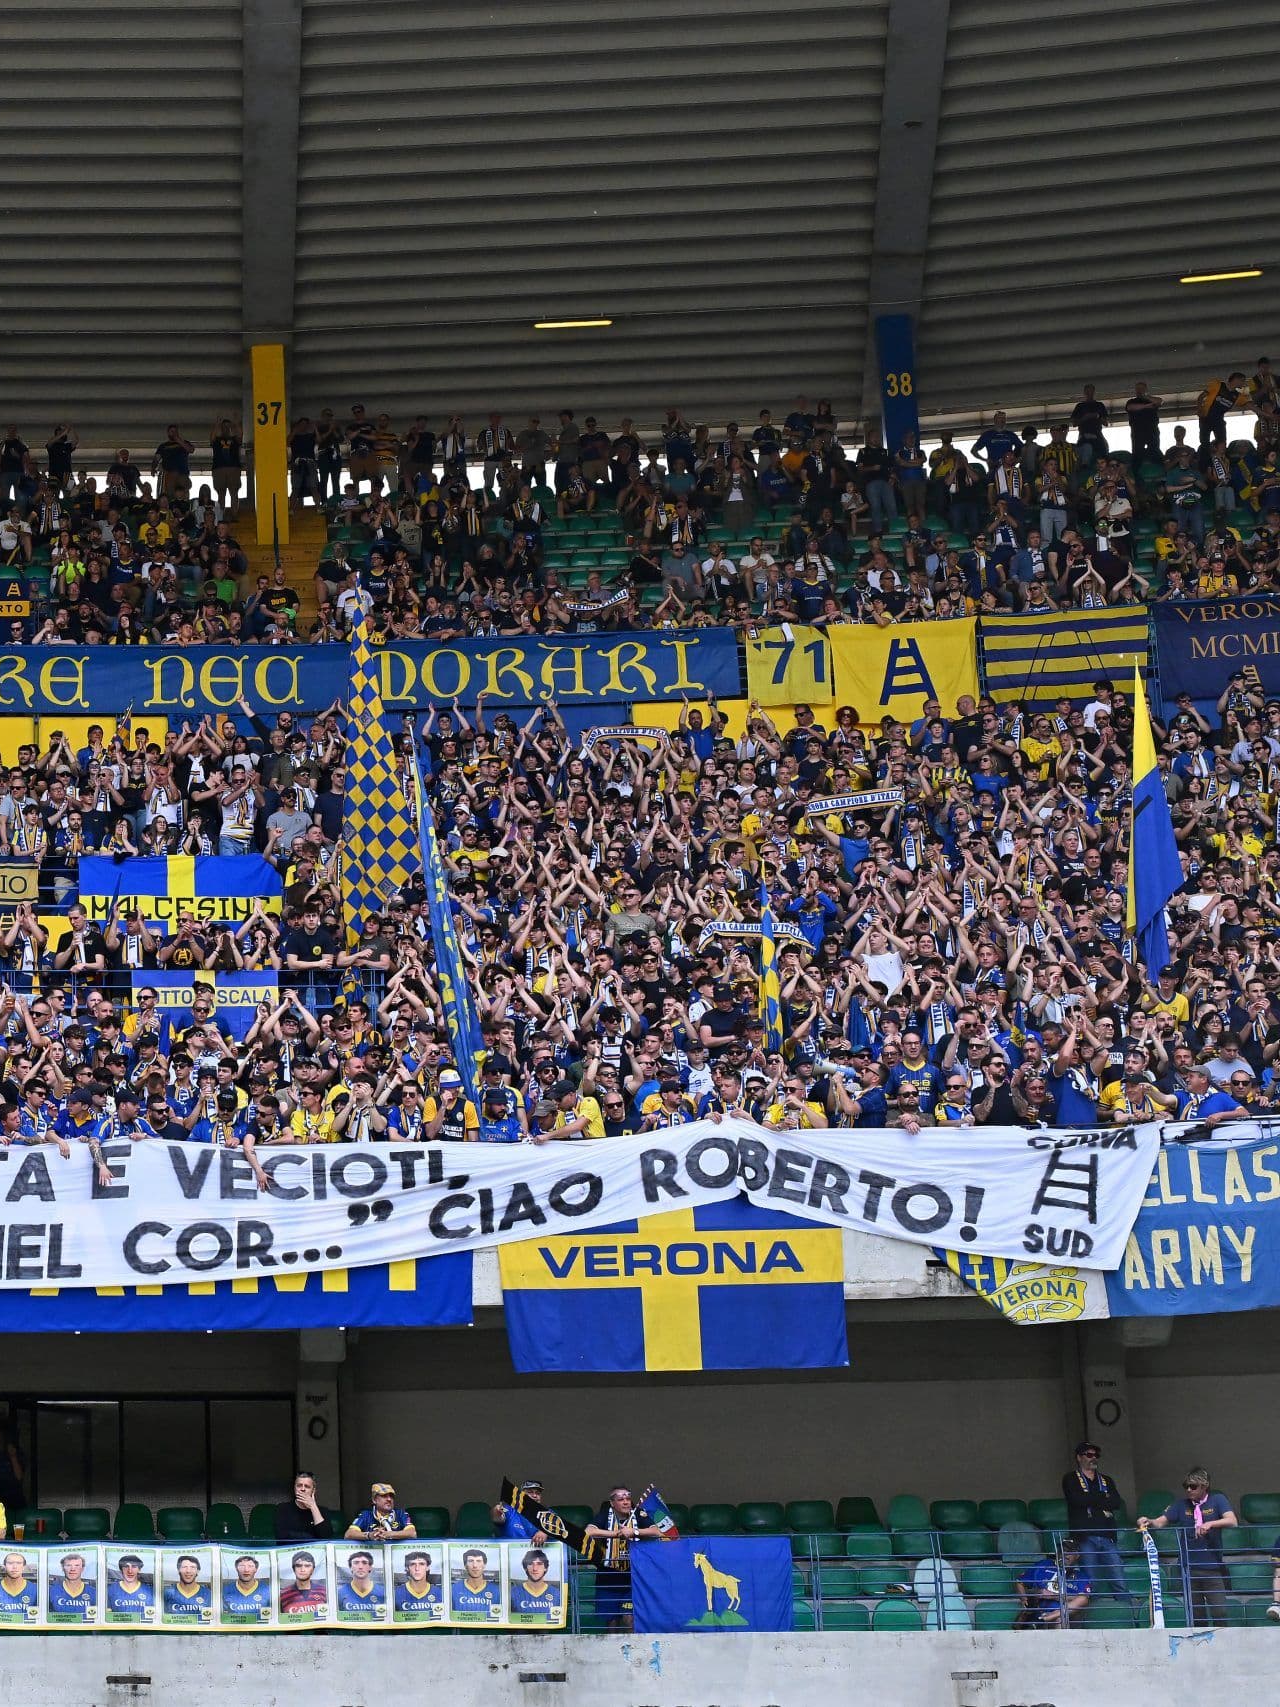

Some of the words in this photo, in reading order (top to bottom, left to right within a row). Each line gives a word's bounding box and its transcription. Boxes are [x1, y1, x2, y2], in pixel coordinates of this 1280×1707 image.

[886, 373, 913, 397] 38
[257, 402, 281, 425] 37
[144, 655, 305, 709] NEC
[217, 989, 272, 1004] SCALA
[91, 1144, 132, 1200] E
[428, 1170, 604, 1240] CIAO
[639, 1136, 986, 1243] ROBERTO!
[1142, 1145, 1280, 1207] LLAS
[1022, 1223, 1095, 1258] SUD
[1124, 1225, 1256, 1291] ARMY
[538, 1241, 804, 1279] VERONA
[988, 1279, 1079, 1314] VERONA
